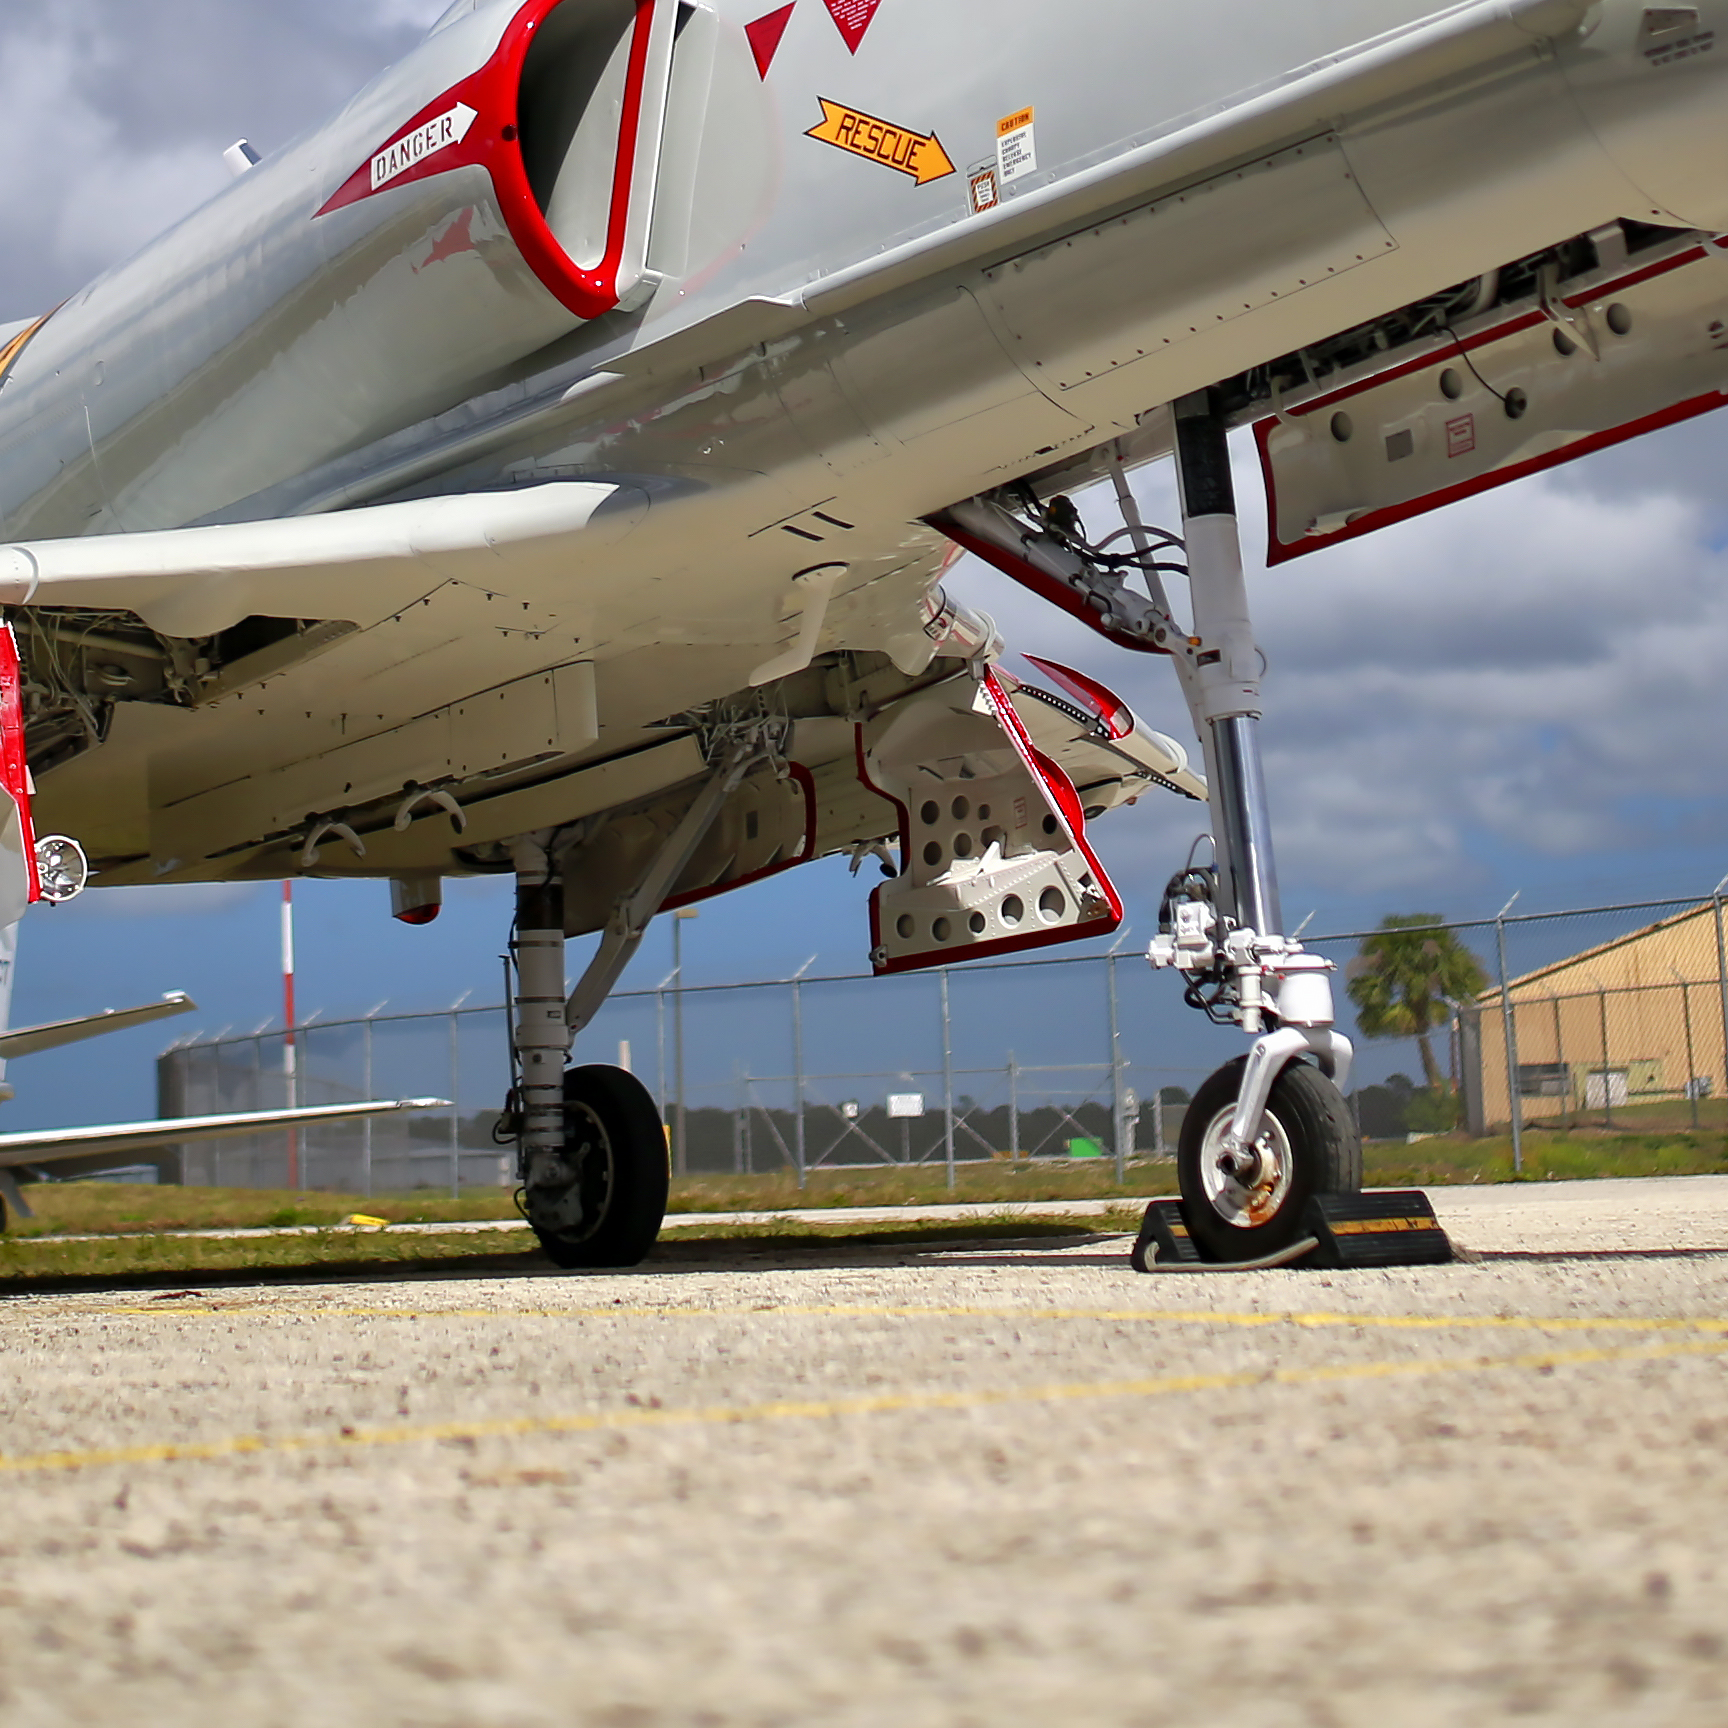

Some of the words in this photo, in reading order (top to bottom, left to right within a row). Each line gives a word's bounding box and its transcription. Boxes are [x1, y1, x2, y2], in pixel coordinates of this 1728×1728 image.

[376, 116, 453, 182] DANGER
[835, 113, 927, 172] RESCUE
[1001, 112, 1030, 132] CAUTION
